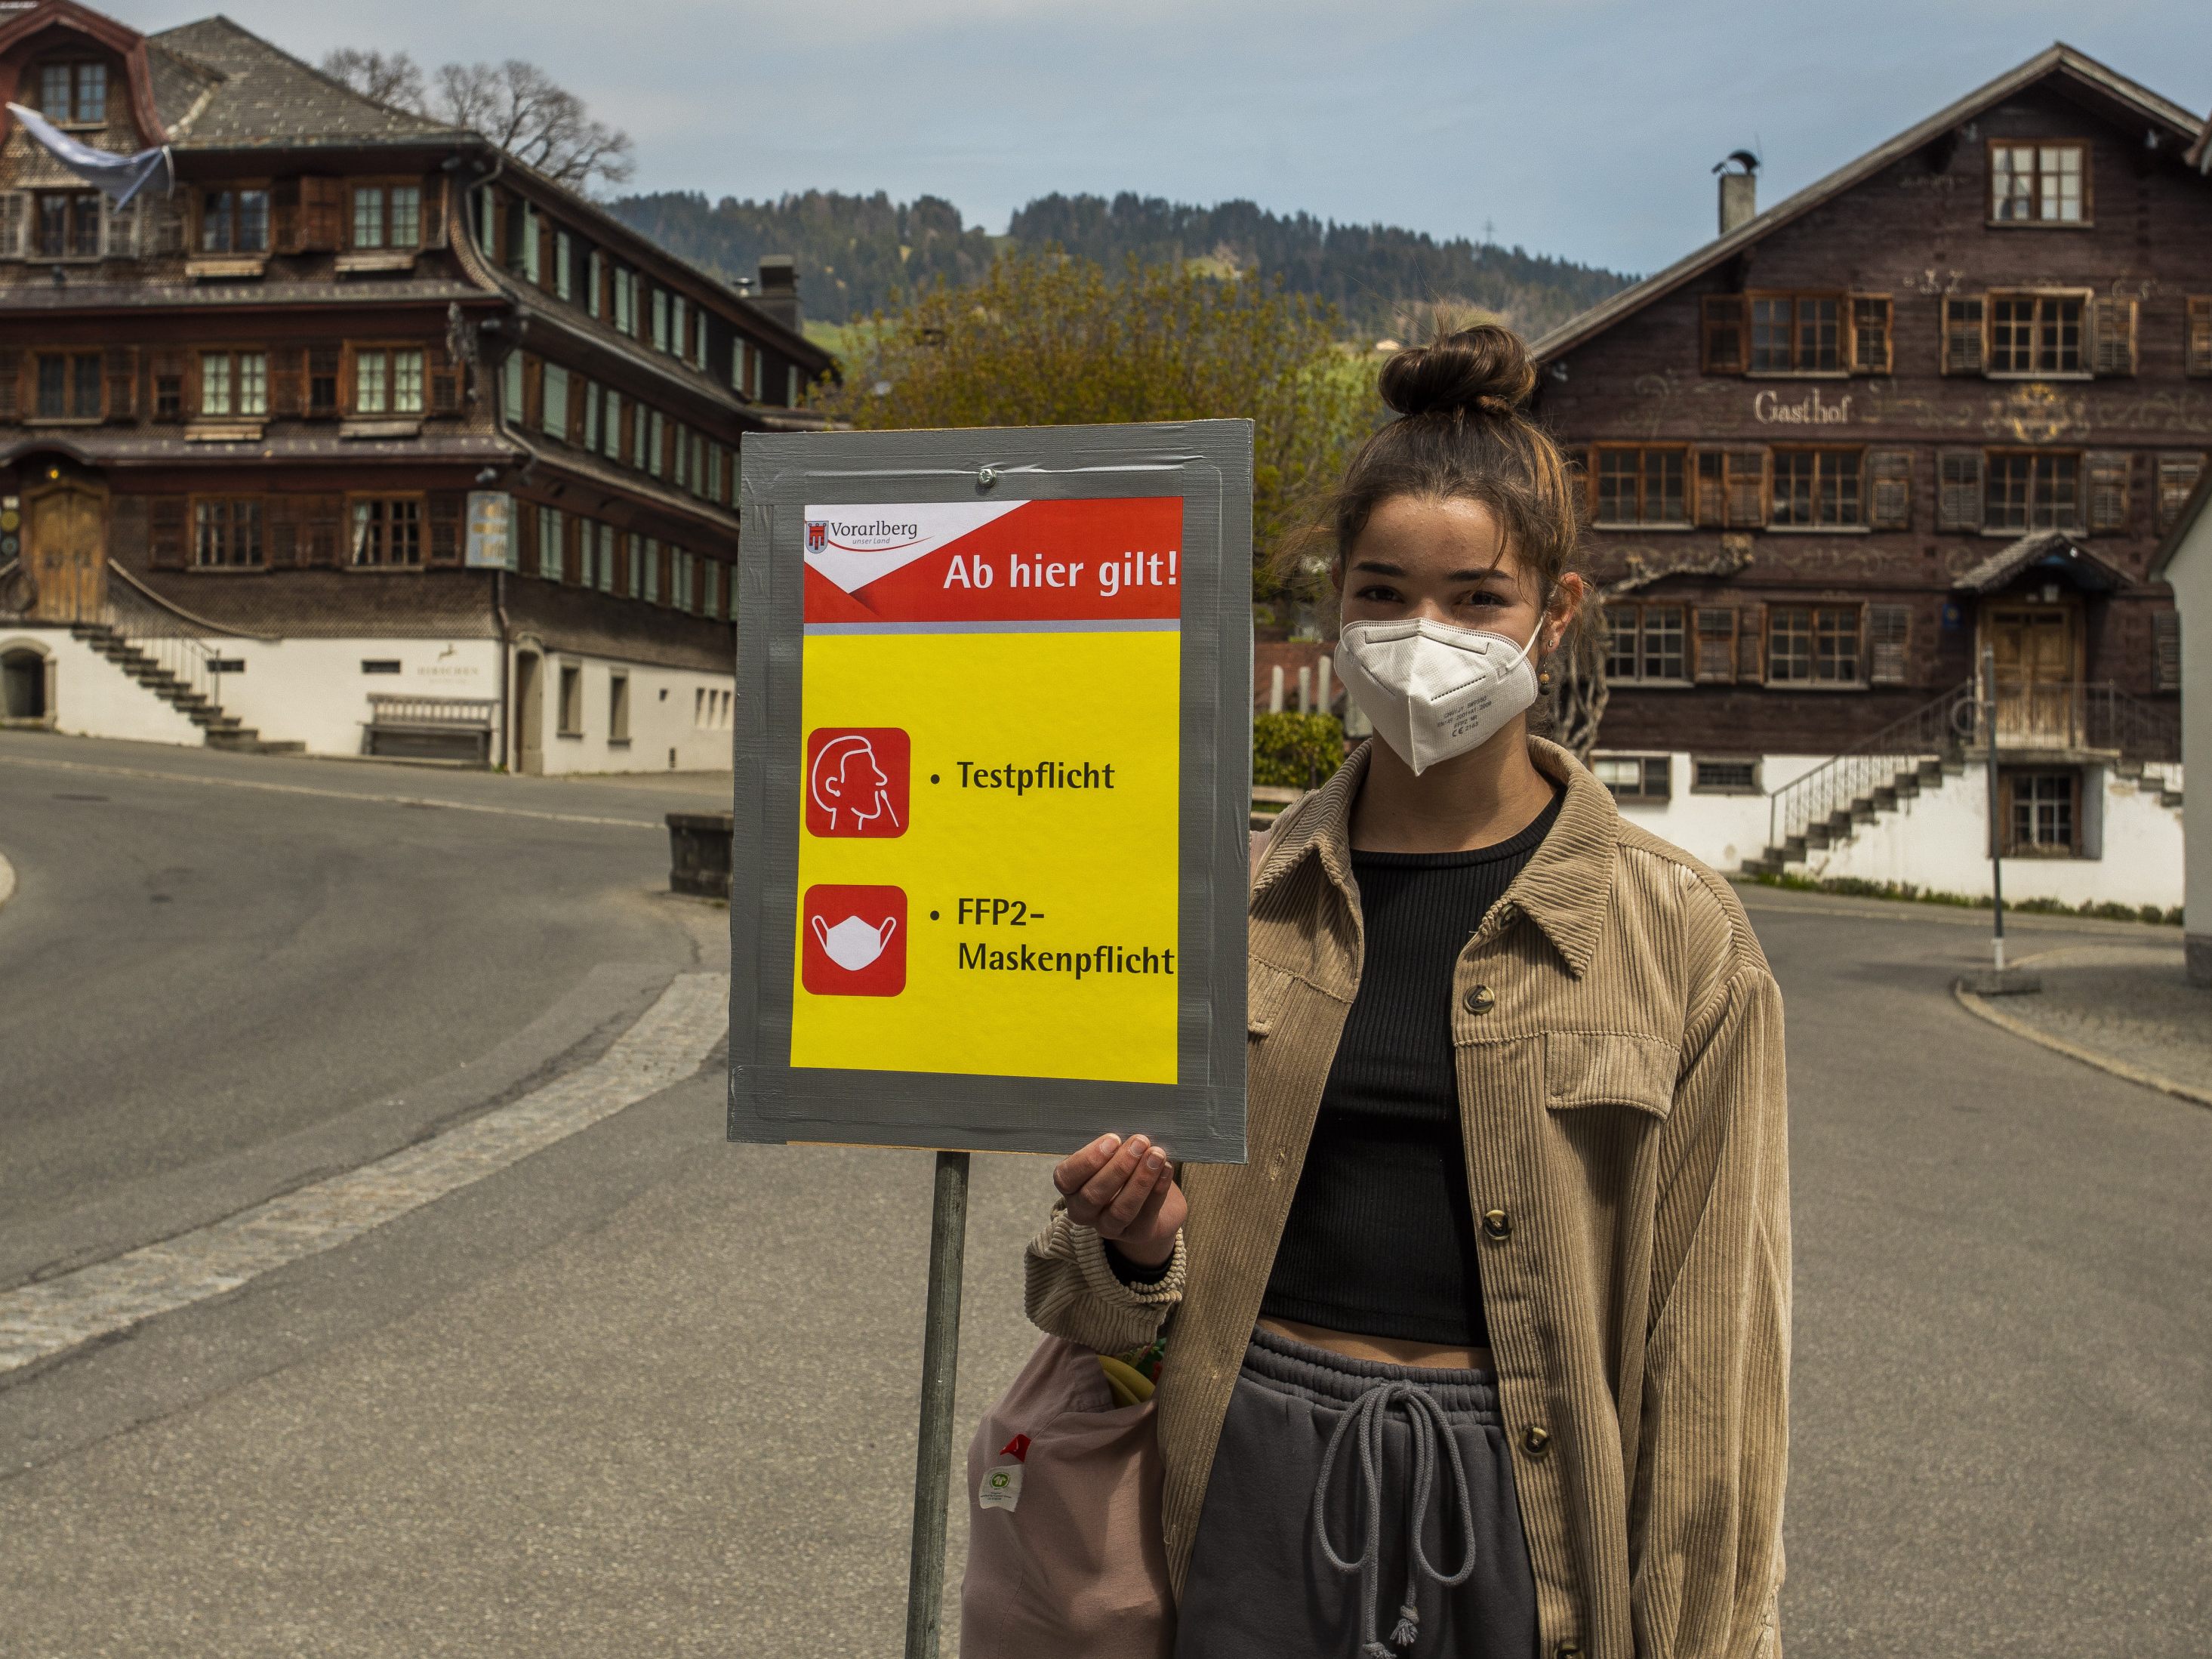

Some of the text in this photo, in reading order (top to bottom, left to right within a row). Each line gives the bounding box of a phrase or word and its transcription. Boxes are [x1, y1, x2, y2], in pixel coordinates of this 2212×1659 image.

[1754, 387, 1853, 424] Gasthof
[831, 521, 917, 539] Vorarlberg
[943, 550, 1178, 597] Ab hier gilt!
[957, 761, 1115, 796] Testpflicht
[957, 898, 1045, 926] FFP2-
[958, 942, 1175, 981] Maskenpflicht
